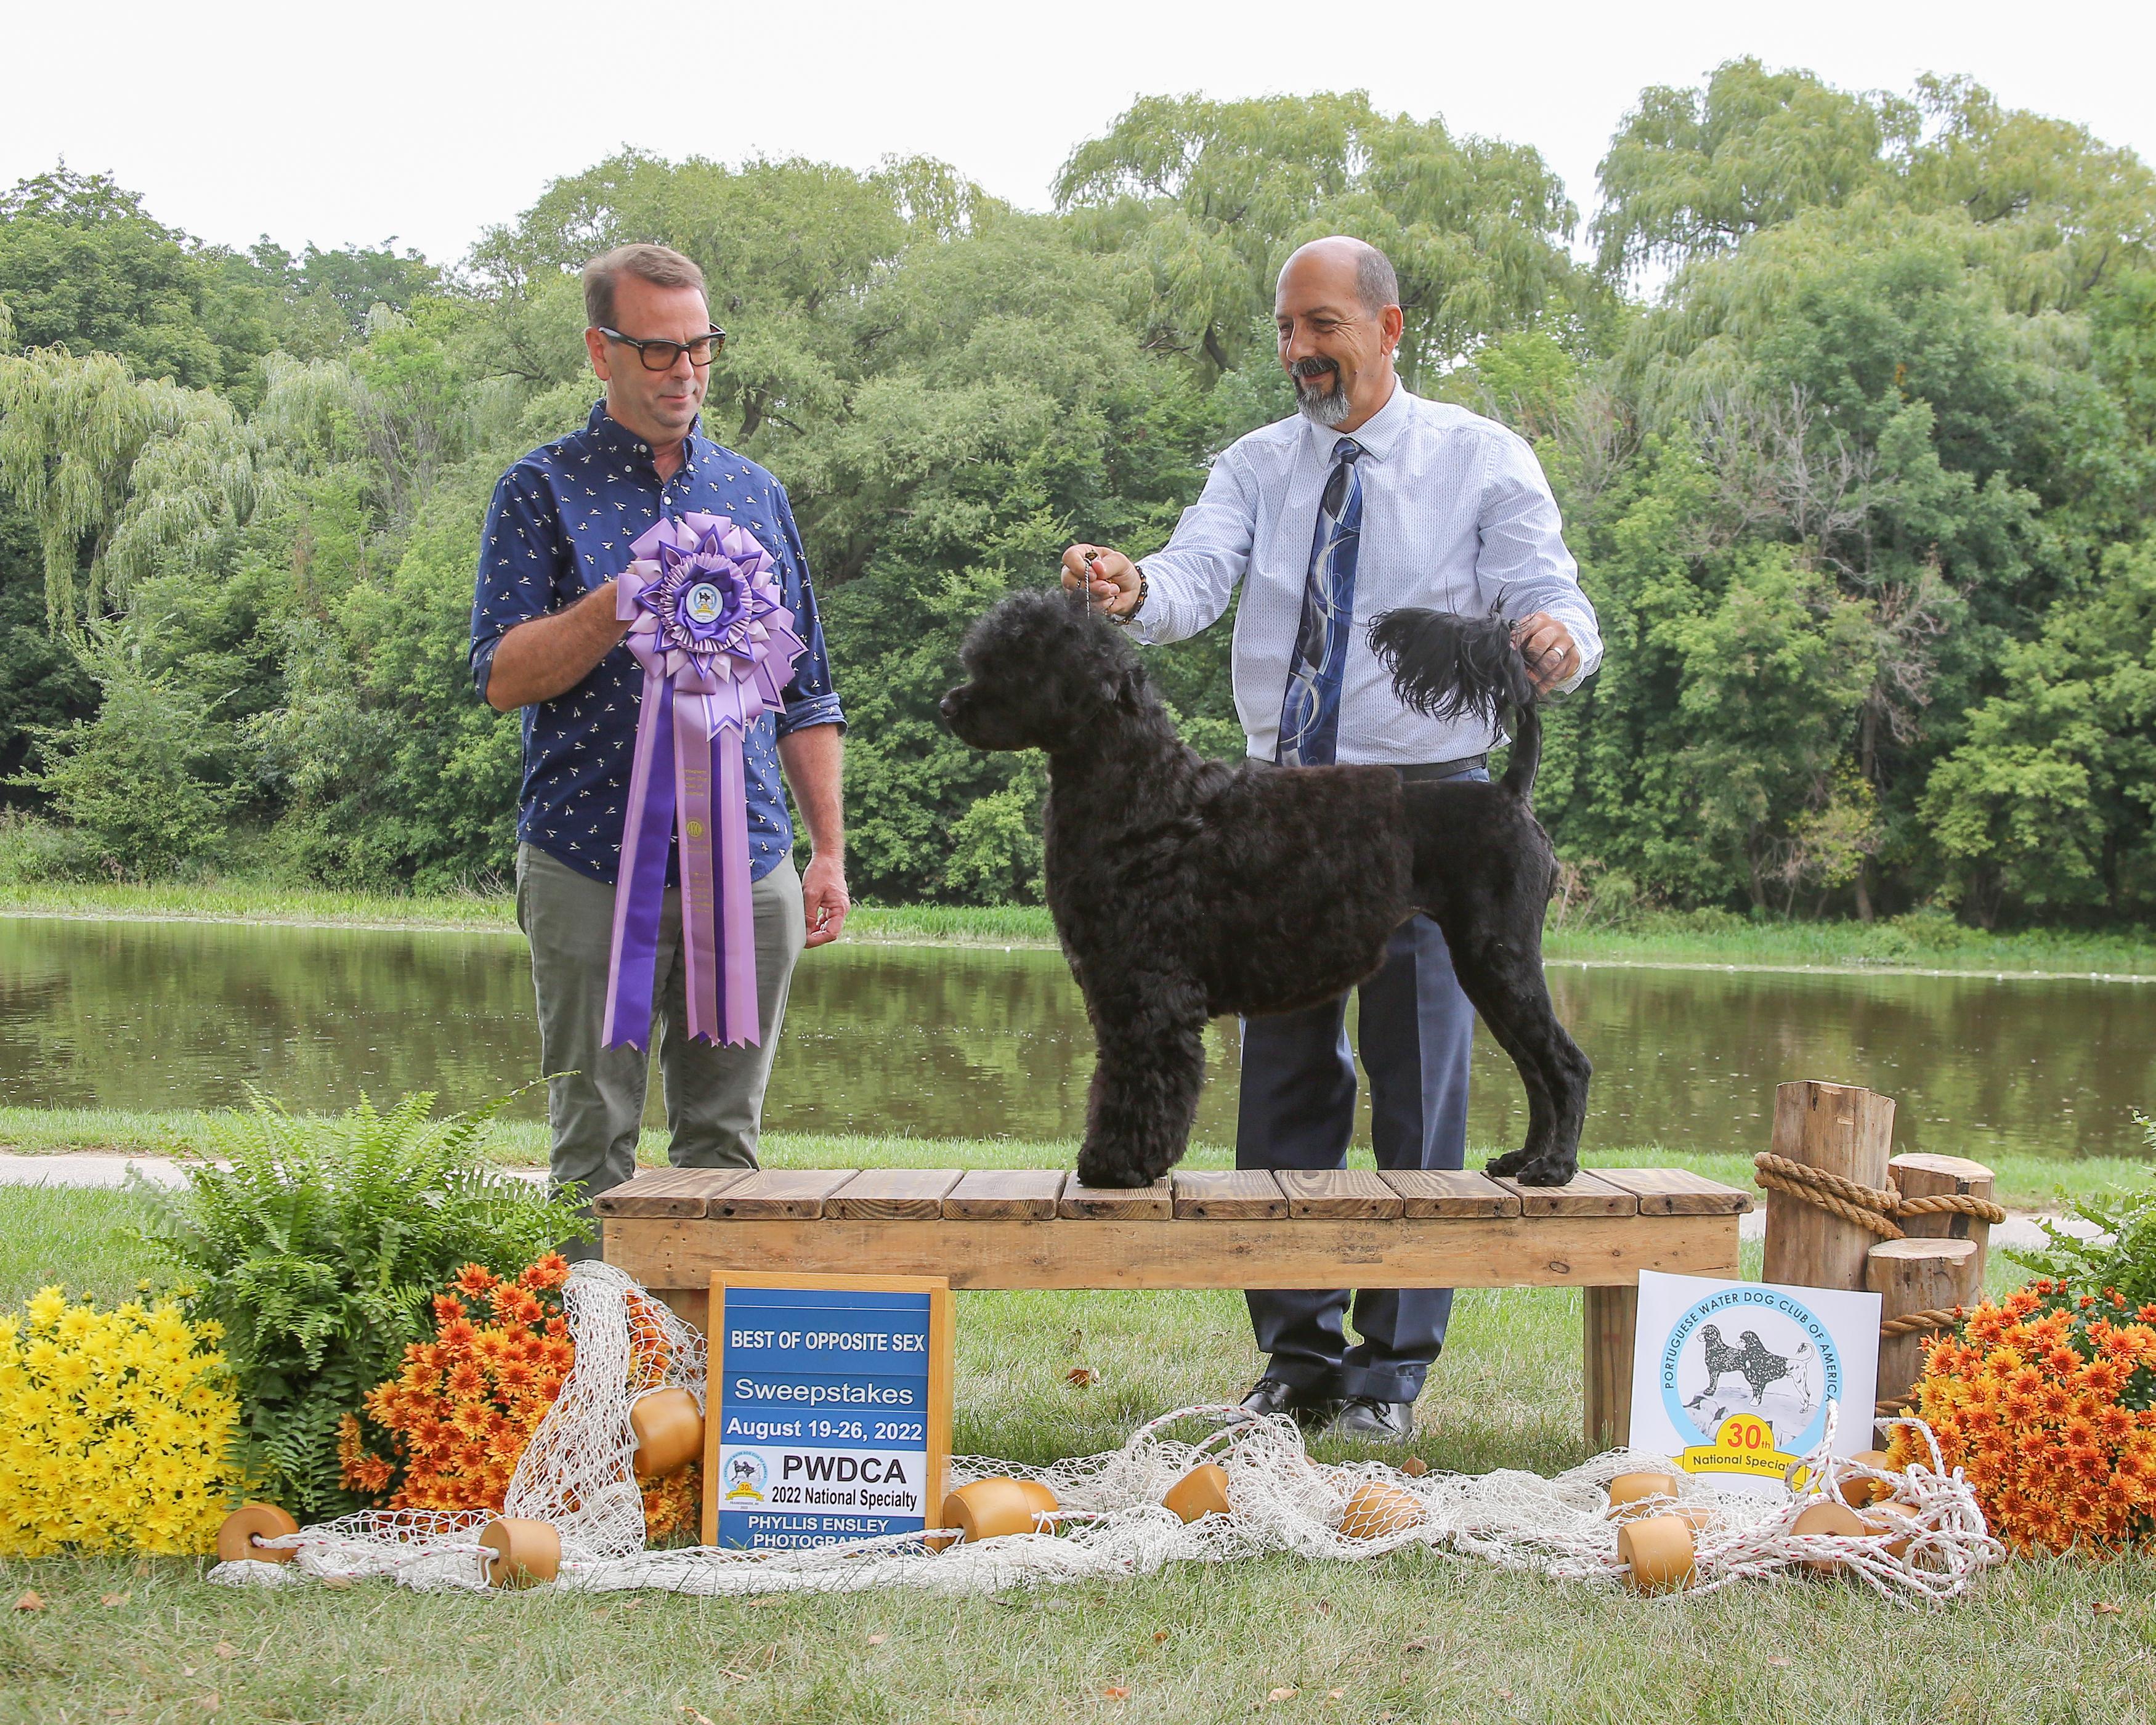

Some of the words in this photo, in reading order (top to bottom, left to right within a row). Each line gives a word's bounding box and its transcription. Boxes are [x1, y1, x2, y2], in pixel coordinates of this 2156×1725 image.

[731, 1329, 775, 1349] BEST
[778, 1331, 801, 1350] OF
[805, 1331, 888, 1352] OPPOSITE
[891, 1333, 926, 1352] SEX
[1664, 1312, 1699, 1389] PORTUGUESE
[1698, 1293, 1739, 1315] WATER
[1744, 1292, 1775, 1305] DOG
[1779, 1300, 1809, 1323] CLUB
[1809, 1324, 1825, 1339] OF
[734, 1378, 914, 1406] Sweepstakes
[726, 1416, 802, 1440] August
[808, 1419, 868, 1442] 19-26,
[873, 1421, 923, 1441] 2022
[1727, 1423, 1770, 1450] 30th
[782, 1455, 907, 1484] PWDCA
[1693, 1455, 1743, 1465] National
[1745, 1455, 1789, 1471] Specia
[771, 1486, 801, 1503] 2022
[804, 1487, 856, 1506] National
[860, 1488, 918, 1512] Specialty
[748, 1515, 818, 1531] PHYLLIS
[822, 1517, 890, 1533] ENSLEY
[753, 1533, 871, 1547] PHOTOGRA
